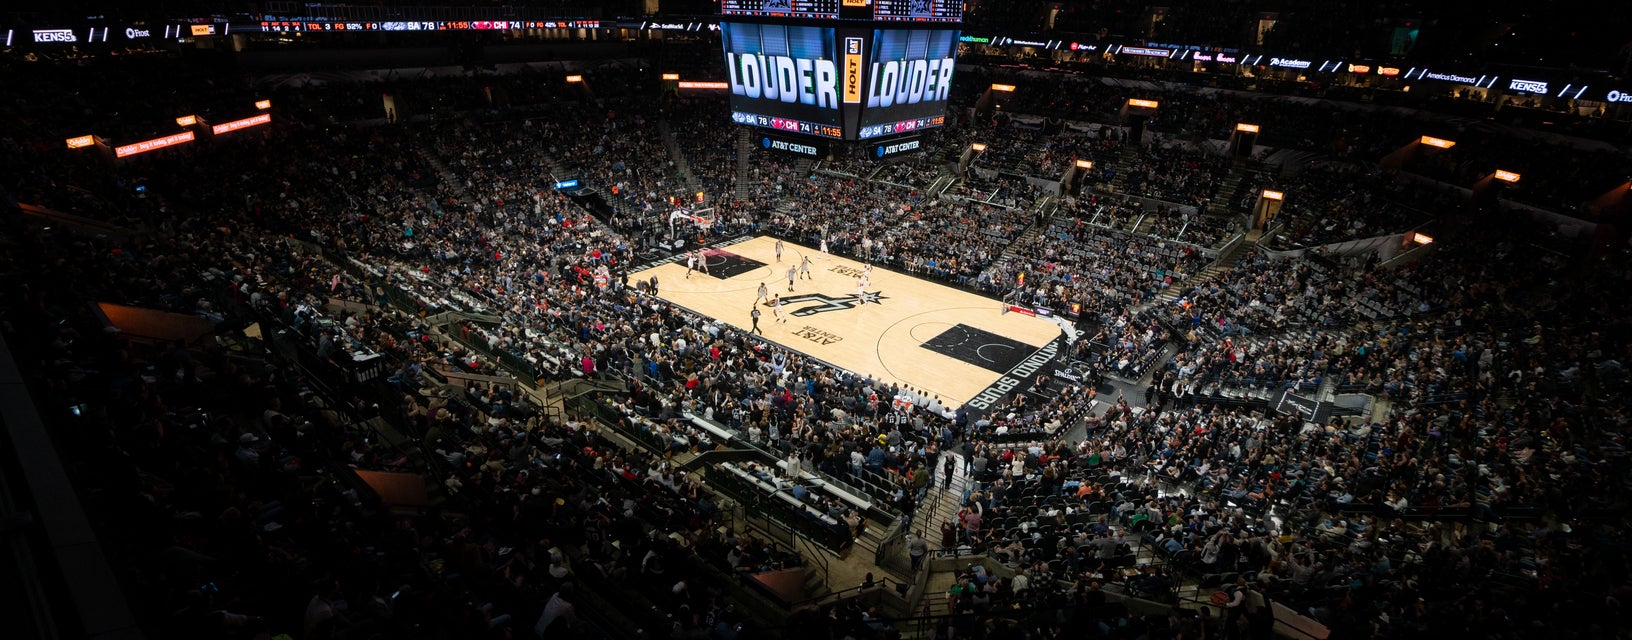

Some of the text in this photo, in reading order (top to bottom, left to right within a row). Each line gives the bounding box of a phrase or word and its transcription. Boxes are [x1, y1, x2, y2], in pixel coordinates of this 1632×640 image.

[407, 22, 421, 30] SA
[422, 22, 435, 30] 78
[493, 21, 521, 30] CHI 74
[135, 29, 150, 37] Frost
[849, 39, 859, 54] CAT
[1280, 59, 1311, 68] Academy
[727, 52, 838, 109] LOUDER
[849, 59, 857, 95] HOLT
[1427, 72, 1476, 84] Americus Diamond
[867, 59, 954, 108] LOUDER
[1619, 93, 1632, 102] Fro
[746, 115, 768, 126] SA 78
[906, 120, 924, 130] CHI 74
[932, 117, 945, 125] 11:55
[785, 121, 798, 131] CHI
[800, 123, 810, 132] 74
[822, 127, 842, 137] 11:55
[873, 125, 892, 135] SA 78
[771, 140, 817, 155] AT&T CENTER
[885, 140, 920, 155] AT&T CENTER
[791, 329, 836, 346] AT&T
[802, 326, 843, 342] CENTER
[968, 376, 1020, 410] SPURS
